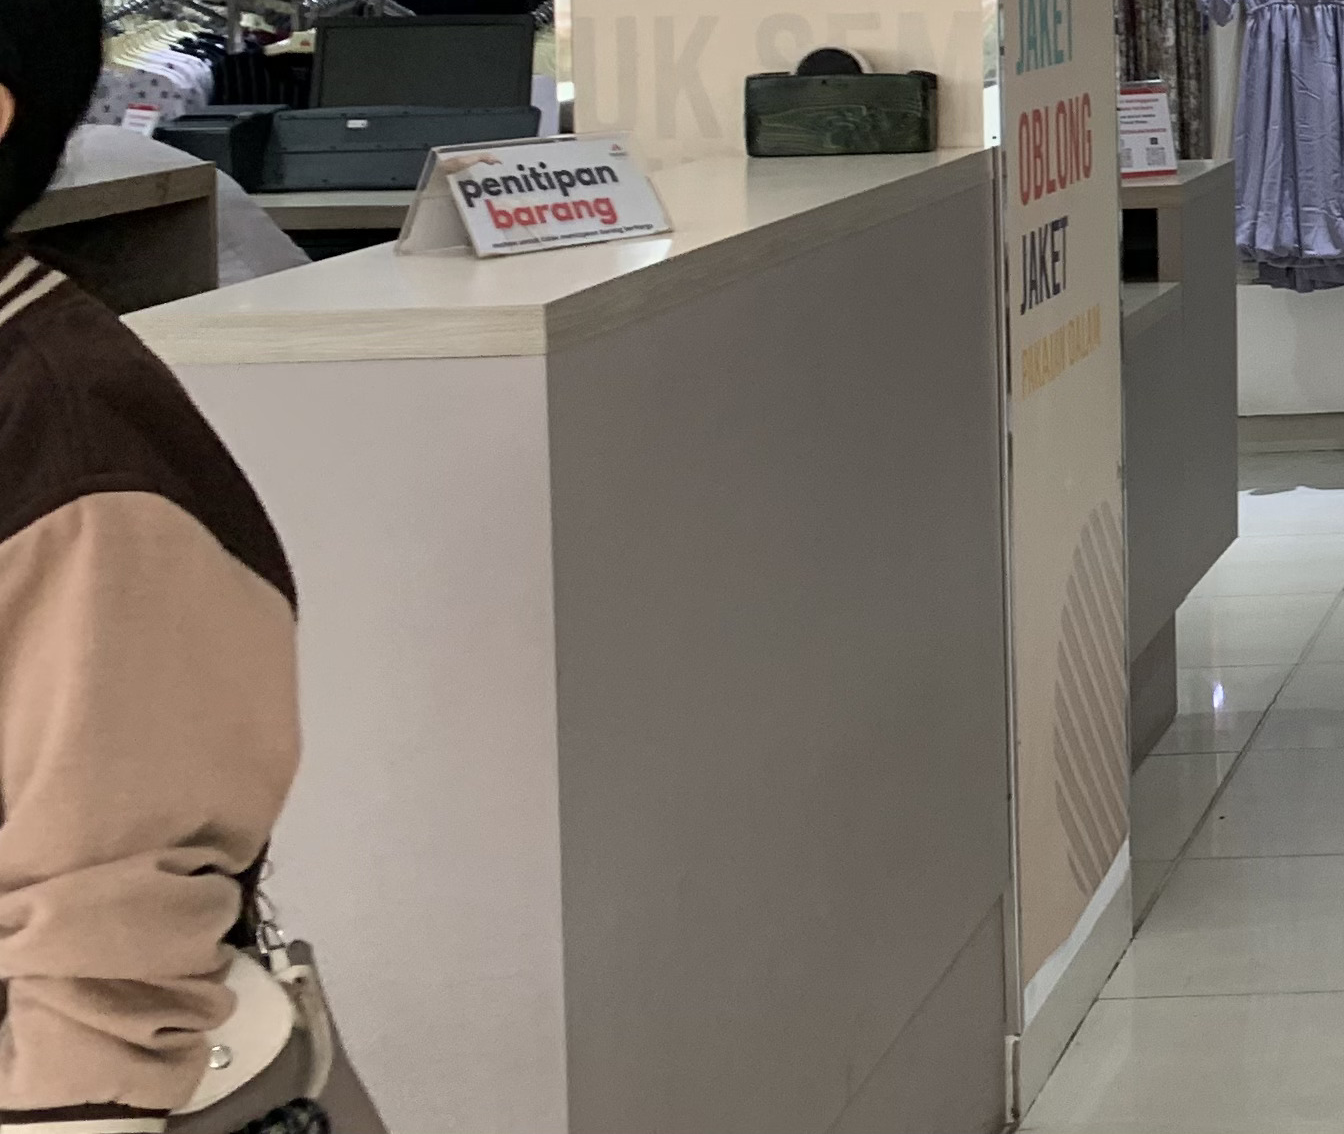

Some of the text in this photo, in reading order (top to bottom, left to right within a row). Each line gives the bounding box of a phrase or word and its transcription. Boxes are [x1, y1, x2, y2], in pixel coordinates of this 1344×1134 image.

[457, 161, 620, 208] penitipan
[1018, 92, 1092, 206] OBLONG
[484, 196, 619, 230] barang
[1020, 214, 1069, 316] JAKET
